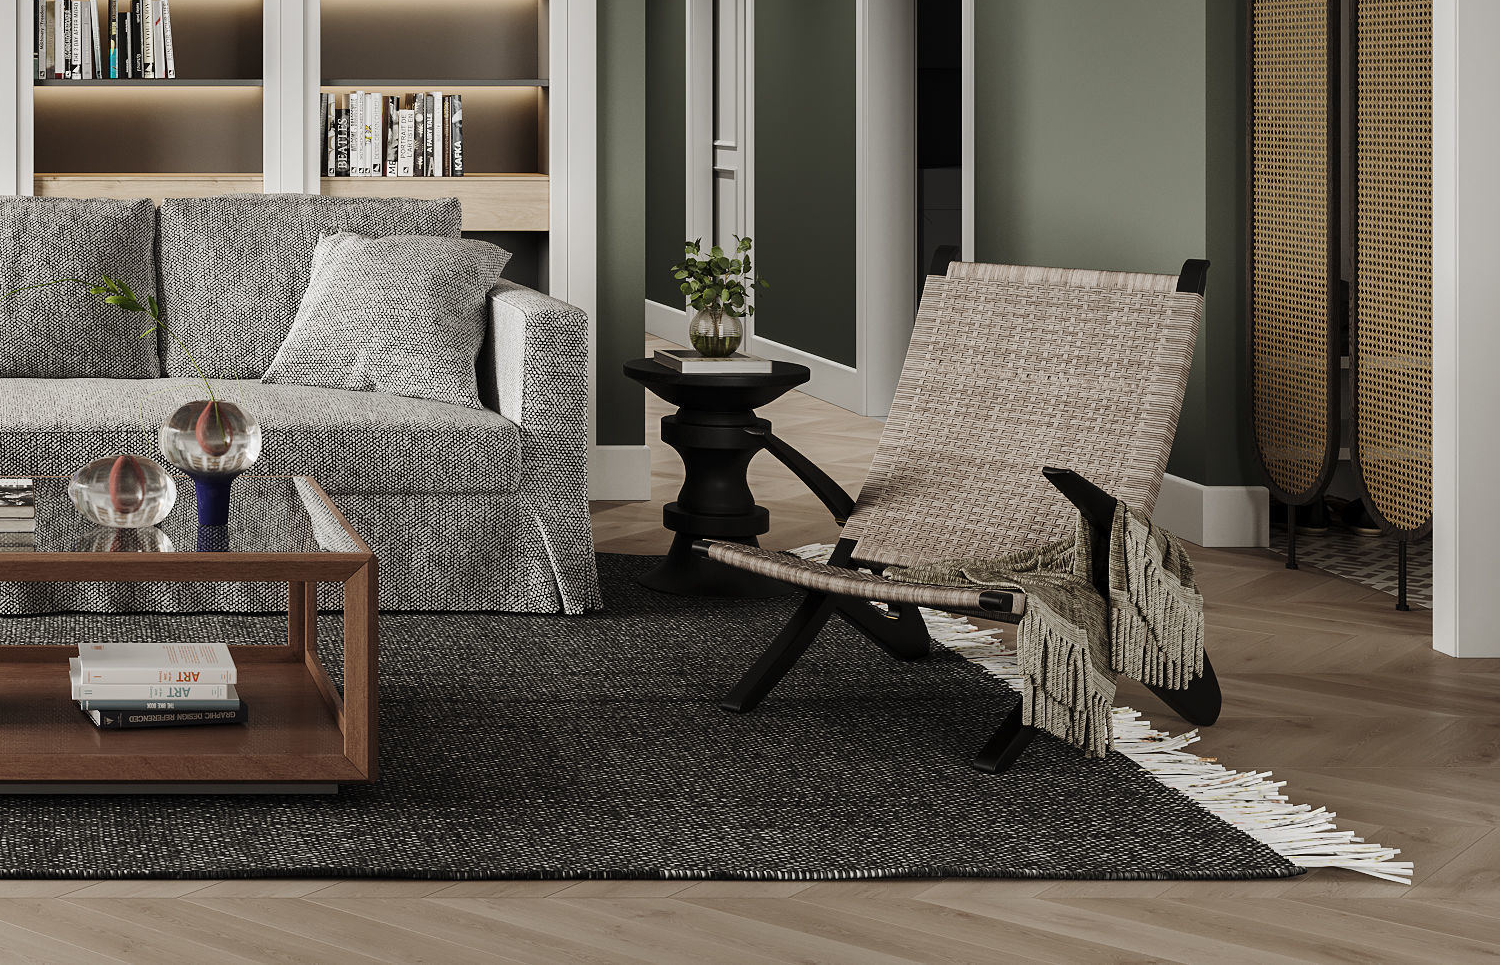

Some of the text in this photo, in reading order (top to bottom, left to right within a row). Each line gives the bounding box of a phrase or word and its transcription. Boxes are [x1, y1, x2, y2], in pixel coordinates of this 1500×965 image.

[400, 114, 407, 124] DE
[407, 113, 414, 123] EN
[337, 118, 348, 169] BEATLES
[454, 140, 463, 171] KAFKA
[176, 671, 201, 683] ART
[166, 687, 191, 698] ART
[128, 714, 176, 723] REFERENCED
[204, 711, 236, 719] GRAPHIC
